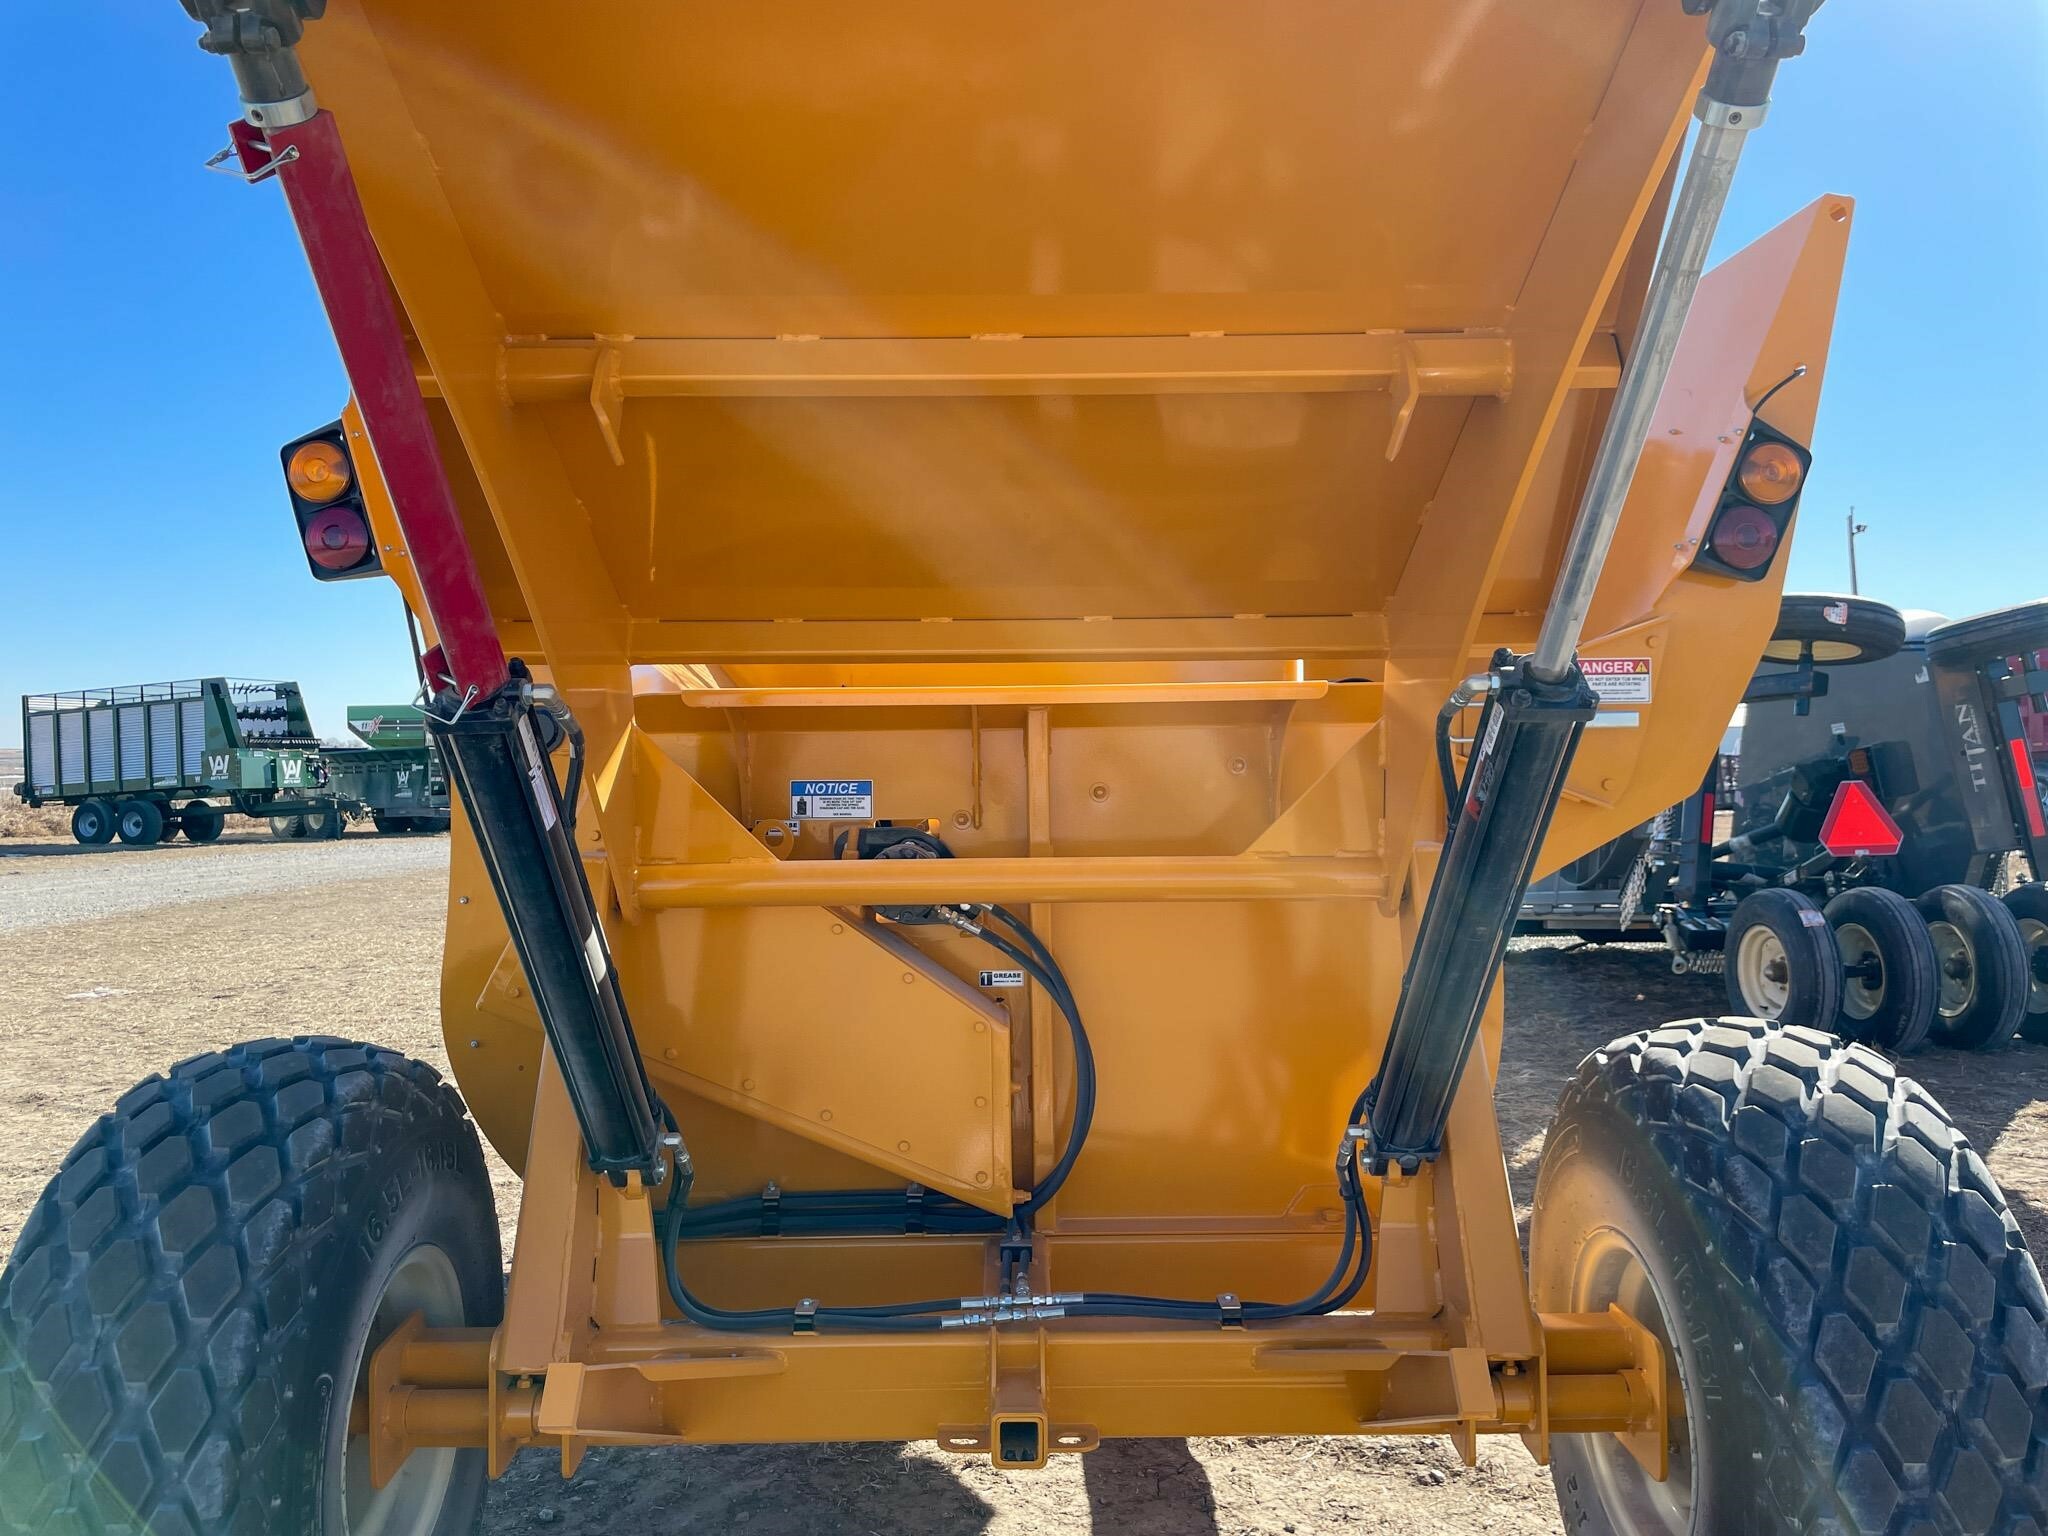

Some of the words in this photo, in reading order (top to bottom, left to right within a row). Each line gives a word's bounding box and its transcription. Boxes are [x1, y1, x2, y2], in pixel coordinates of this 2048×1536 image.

[1578, 661, 1634, 673] ANGER
[1955, 704, 1987, 793] TITAN
[805, 783, 858, 794] NOTICE
